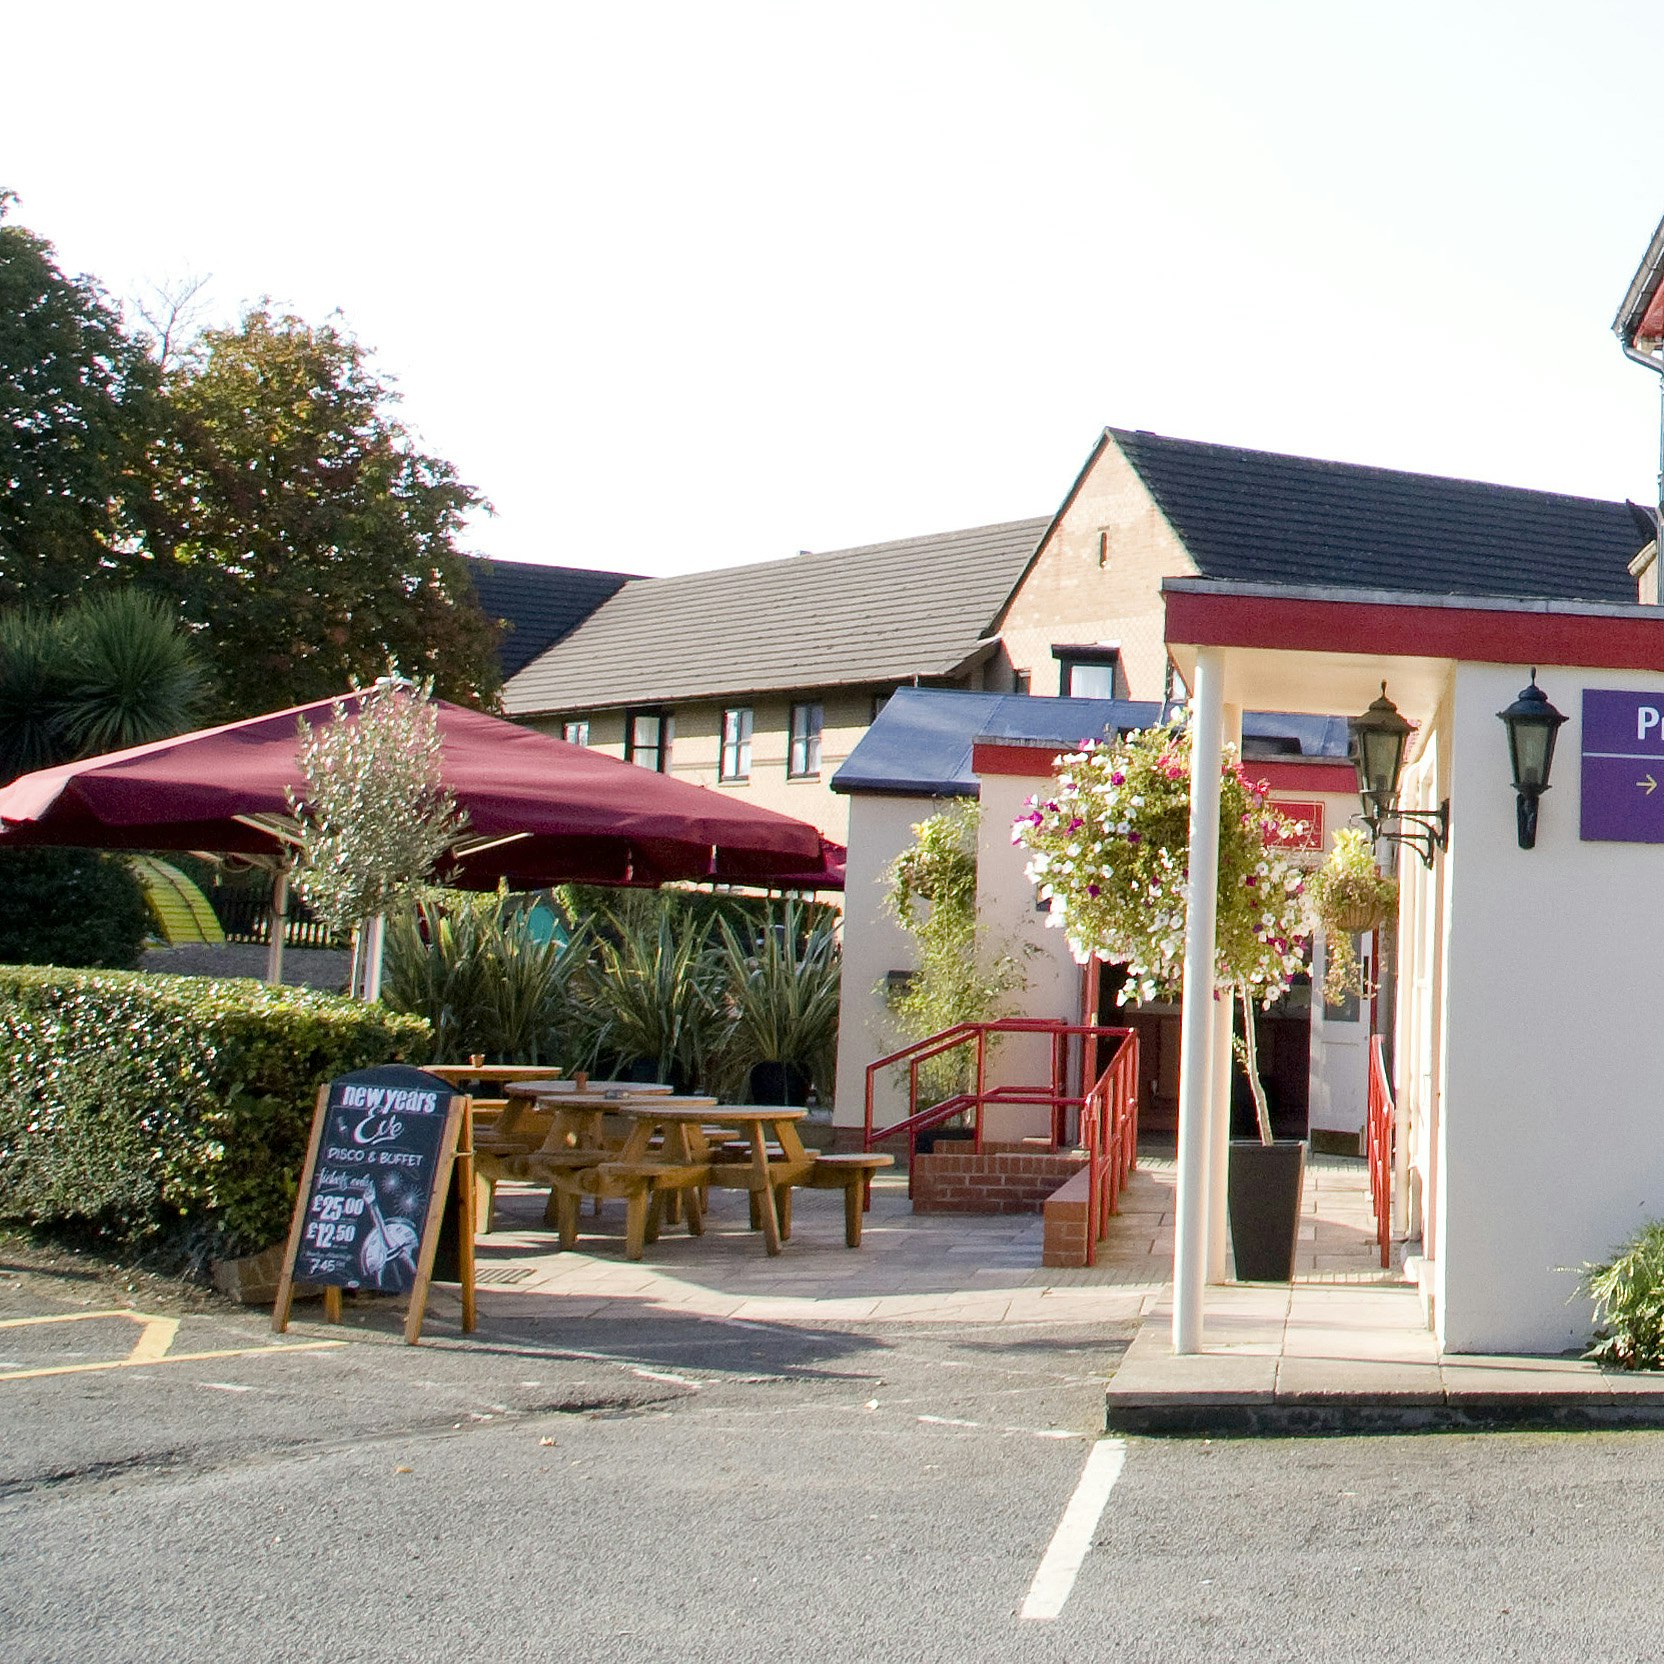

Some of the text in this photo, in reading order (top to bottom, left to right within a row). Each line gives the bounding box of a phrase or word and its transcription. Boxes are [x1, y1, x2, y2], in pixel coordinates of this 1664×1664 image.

[342, 1086, 438, 1114] new years
[353, 1106, 404, 1144] Eve
[327, 1147, 423, 1167] DISCO & BUFFET
[305, 1222, 356, 1248] £12.50
